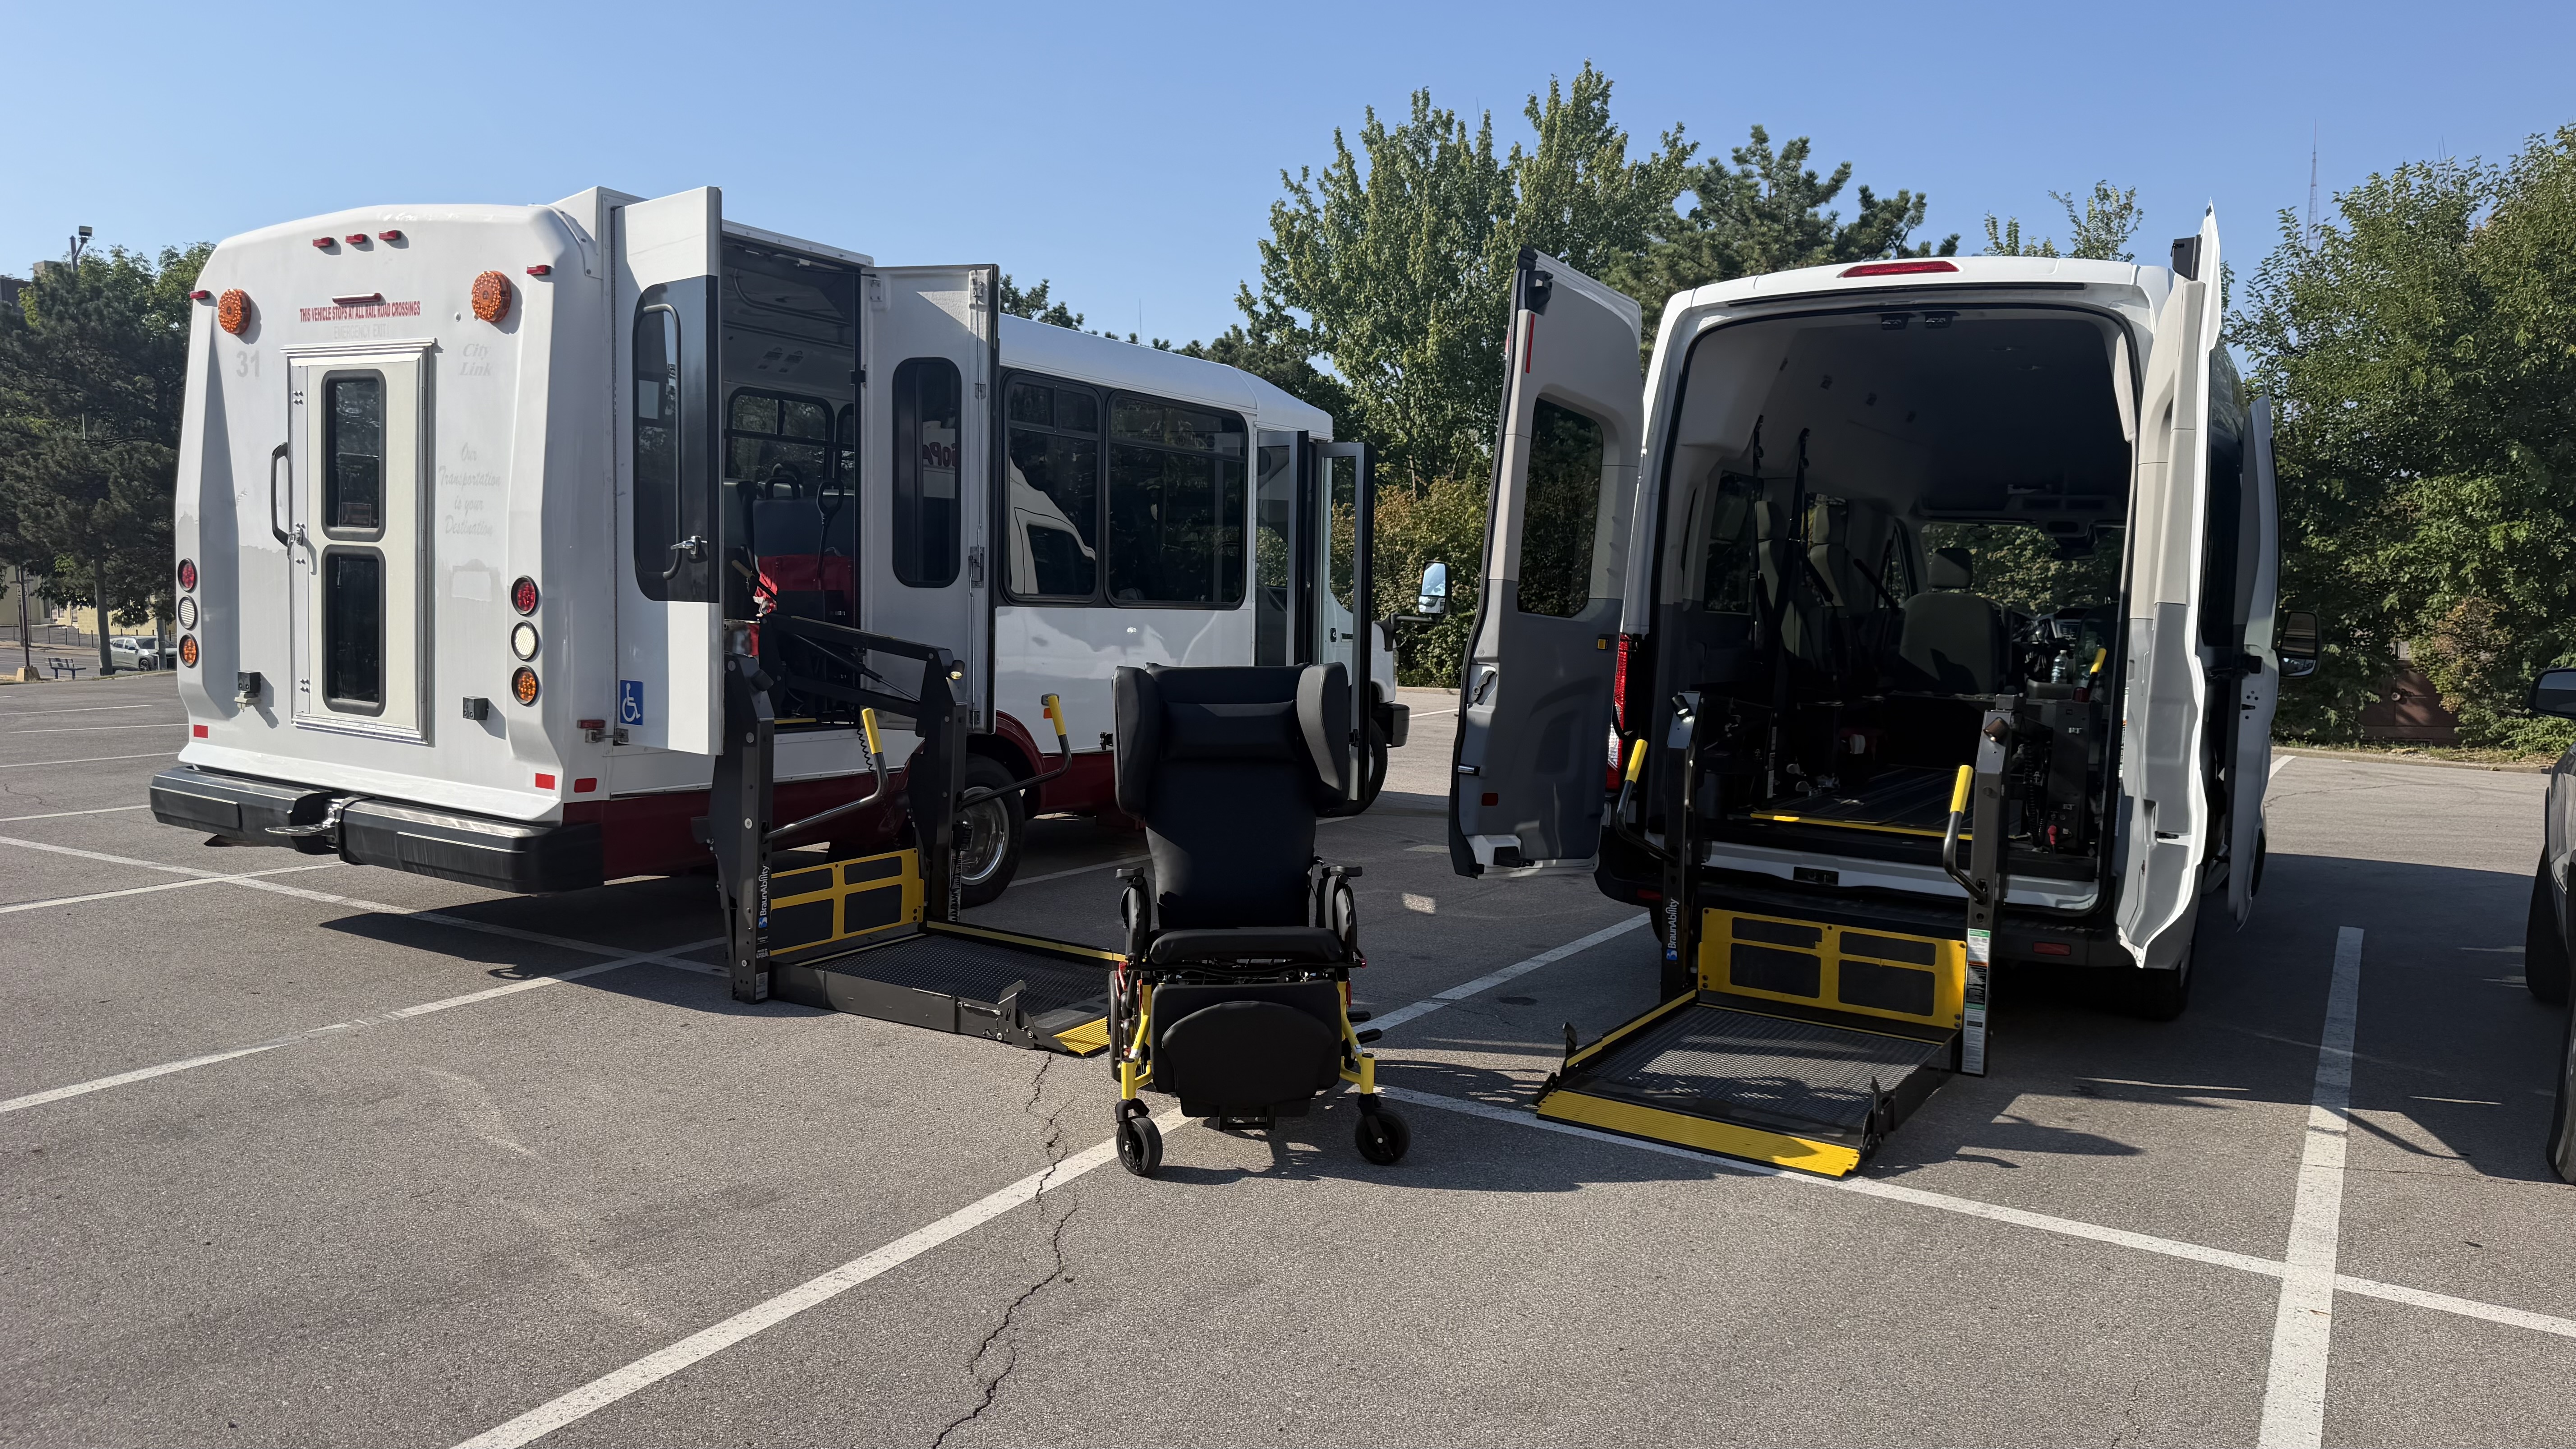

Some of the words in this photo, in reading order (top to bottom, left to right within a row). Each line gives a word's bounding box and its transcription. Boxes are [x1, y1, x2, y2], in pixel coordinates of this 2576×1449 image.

[299, 308, 311, 322] THIS
[312, 307, 331, 322] VEHICLE
[332, 306, 347, 321] STOPS
[348, 305, 354, 320] AT
[355, 304, 364, 319] ALL
[365, 304, 376, 318] RAIL
[377, 302, 391, 318] ROAD
[391, 300, 420, 317] CROSSINGS
[462, 343, 492, 360] City
[236, 350, 260, 377] 31
[459, 362, 492, 376] Link
[461, 442, 477, 461] Our
[438, 465, 501, 492] Transportation
[454, 495, 462, 510] is
[464, 500, 484, 517] your
[445, 514, 493, 537] Destination
[759, 865, 770, 916] BraunAbility
[1665, 898, 1679, 949] BraunAbility
